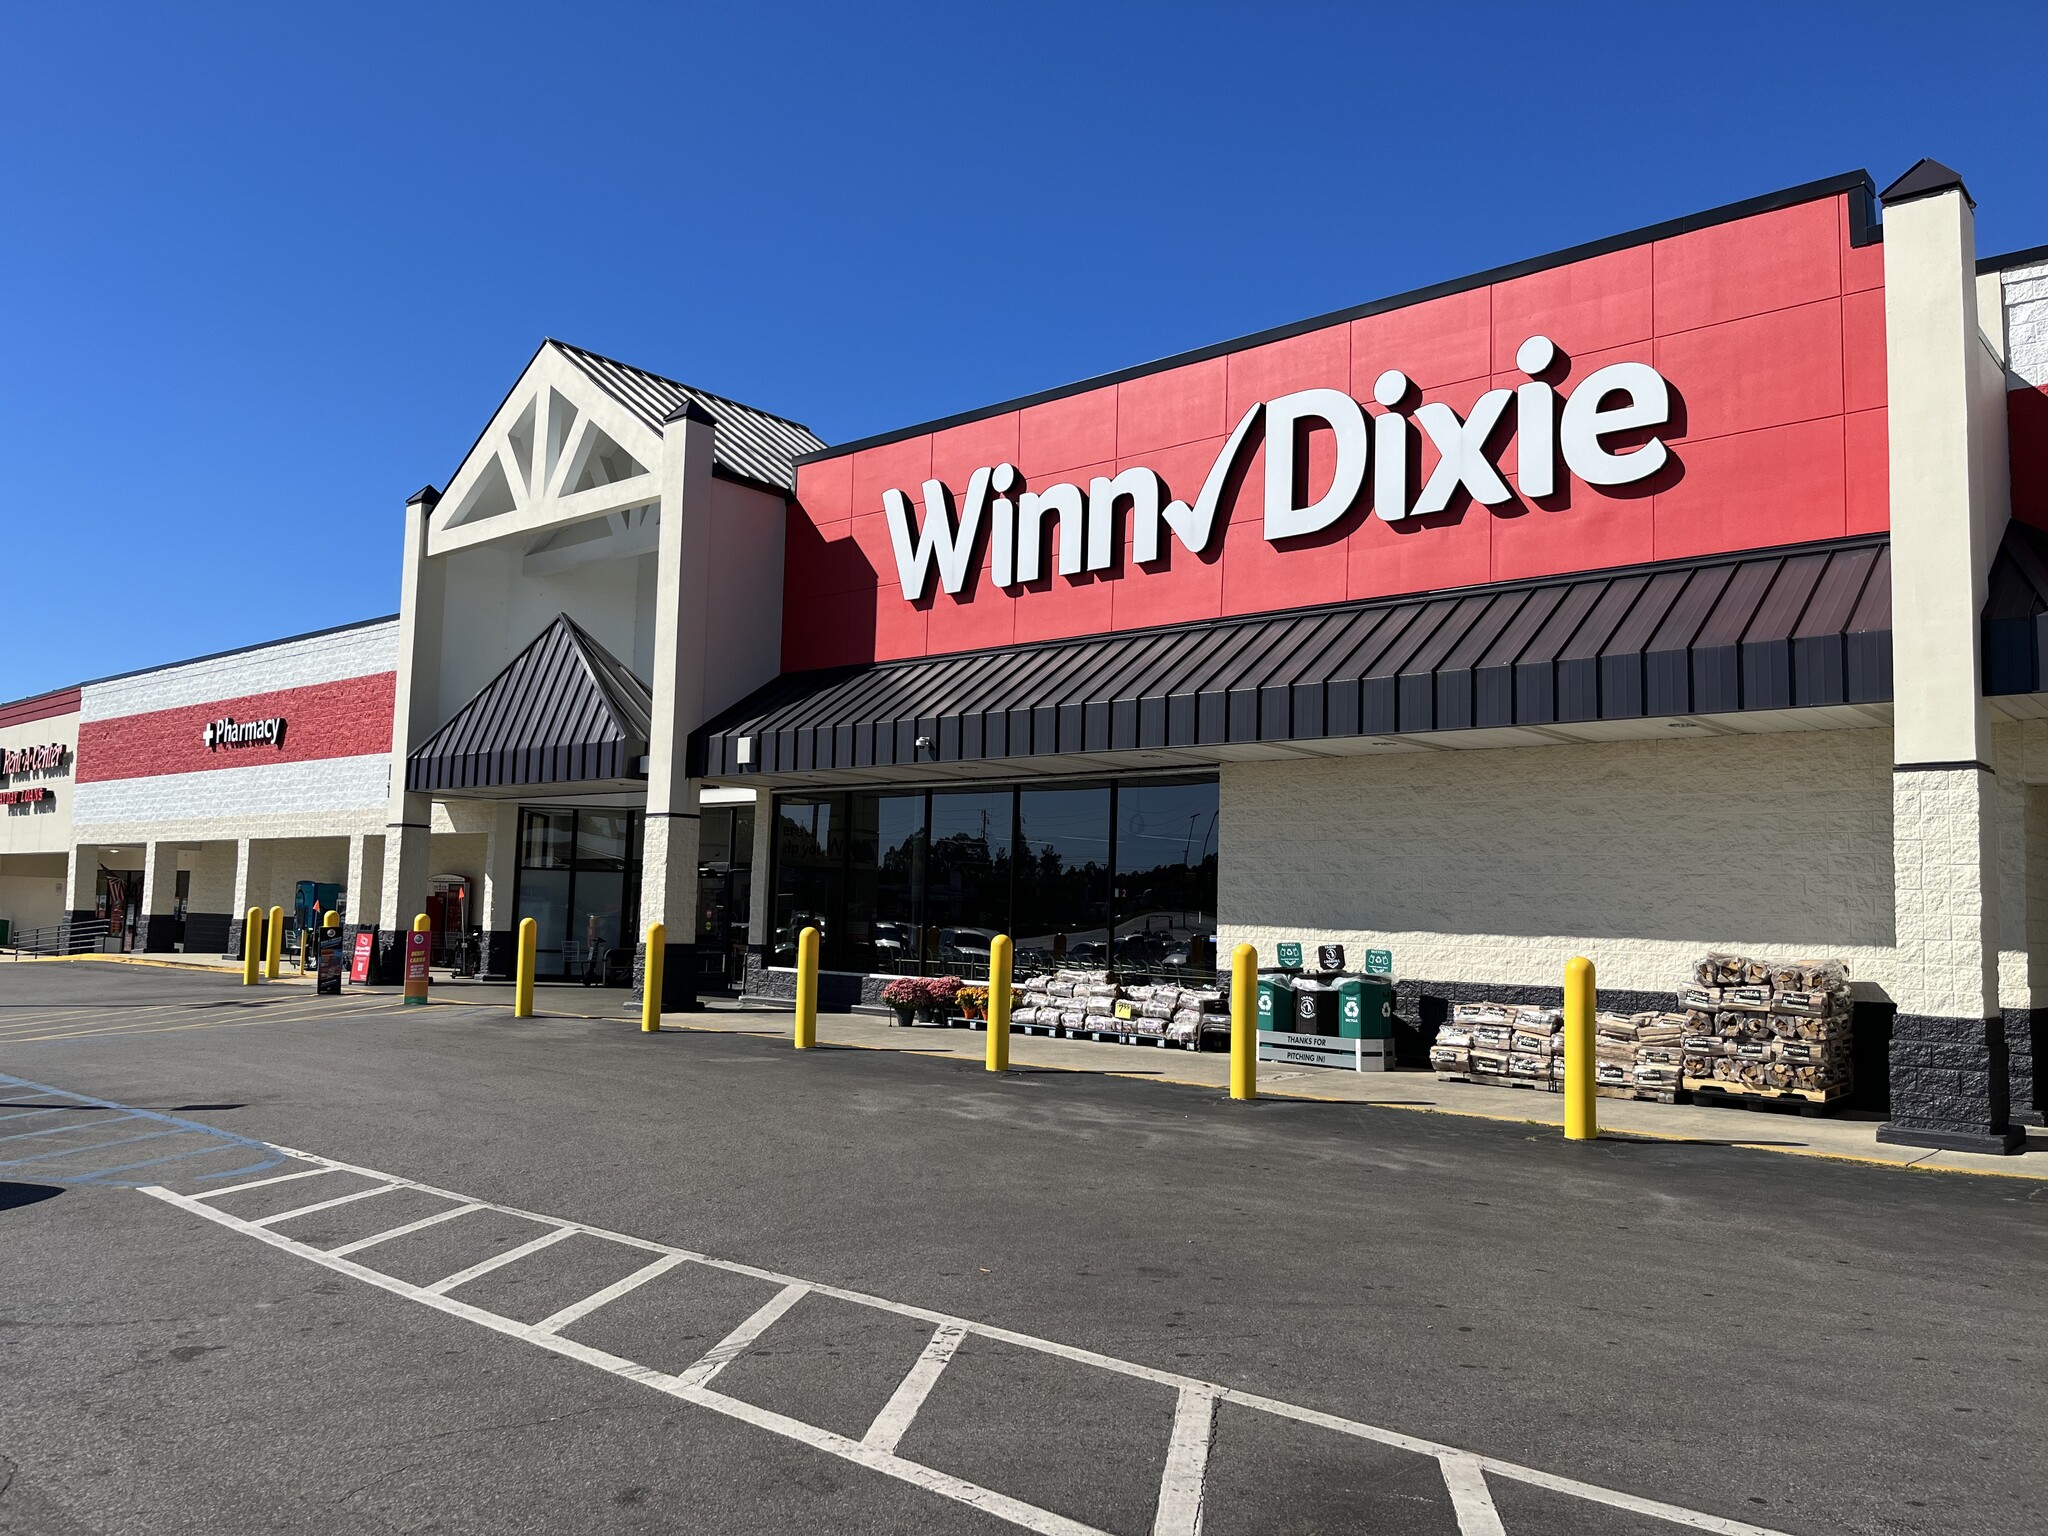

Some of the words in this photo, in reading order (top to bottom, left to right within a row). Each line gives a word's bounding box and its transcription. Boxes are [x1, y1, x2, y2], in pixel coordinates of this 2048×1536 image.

[881, 462, 1161, 603] Winn
[1263, 335, 1671, 542] Dixie
[216, 717, 281, 745] Pharmacy
[21, 788, 43, 802] LOANS
[1287, 1035, 1312, 1045] THANKS
[1313, 1038, 1326, 1046] FOR
[1287, 1051, 1315, 1062] PITCHING
[1316, 1054, 1326, 1063] IN!
